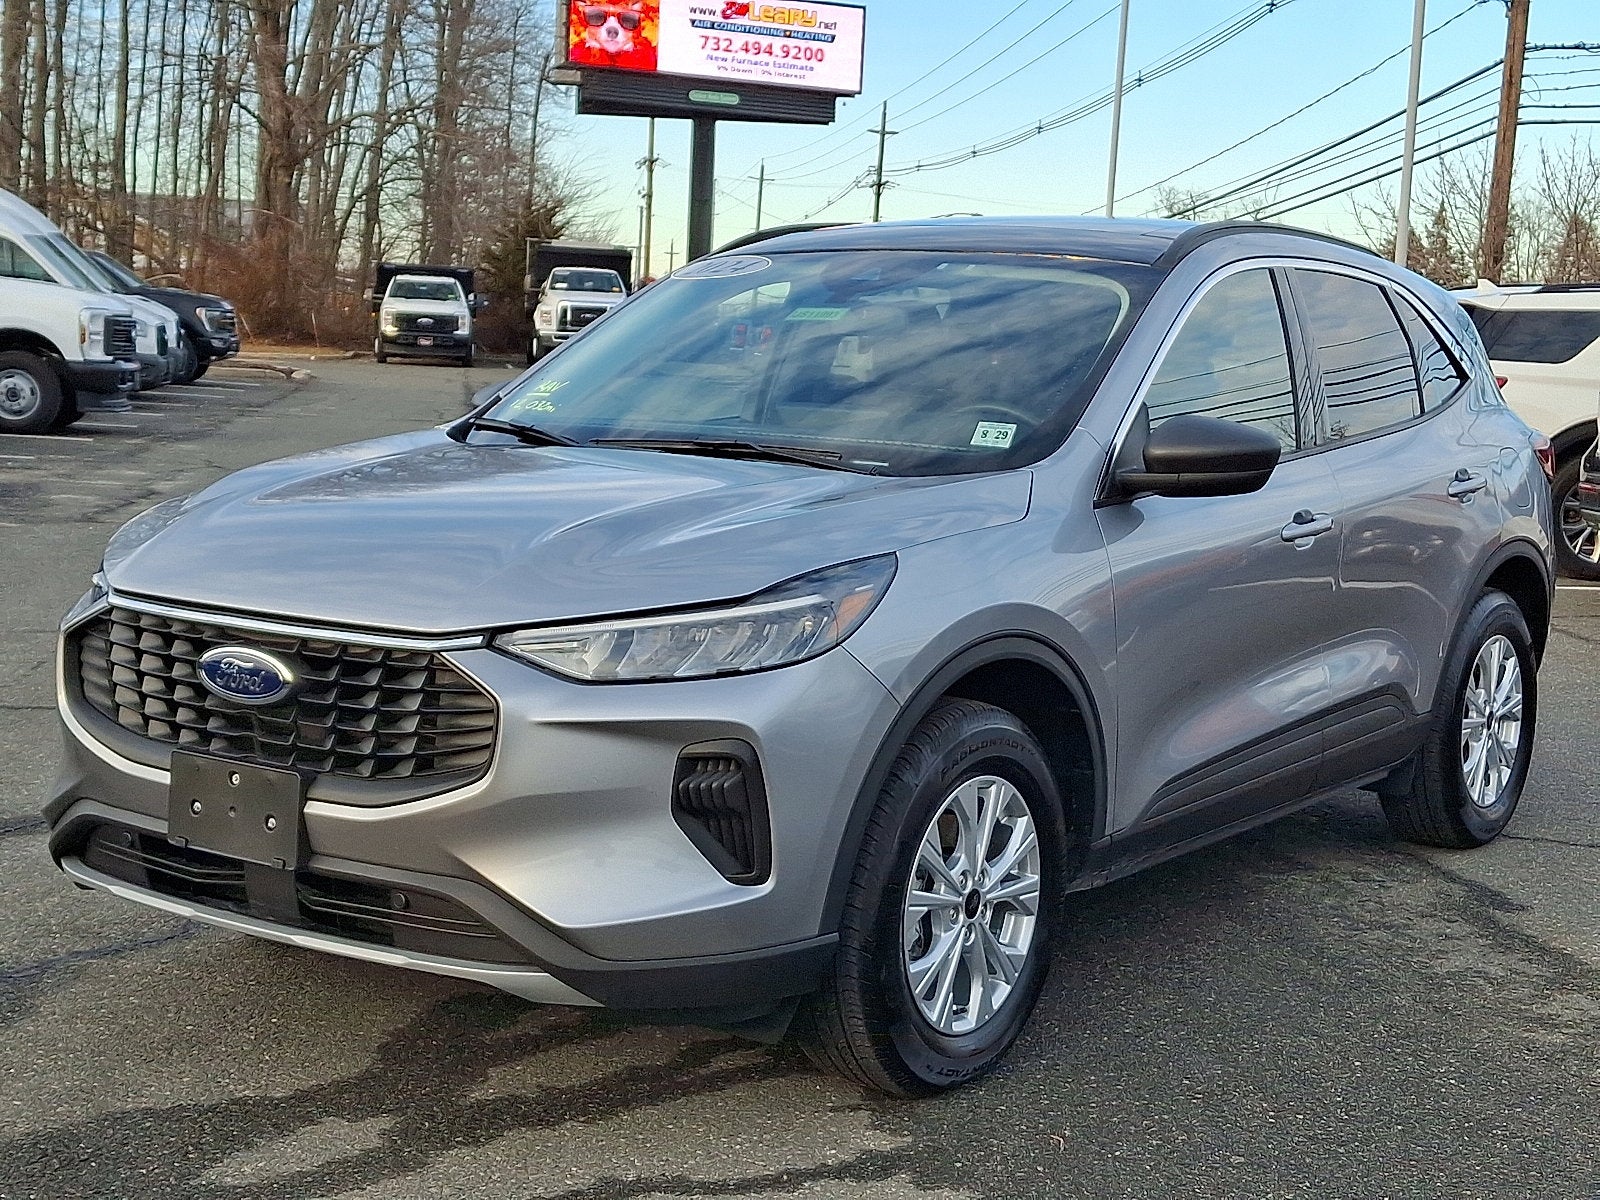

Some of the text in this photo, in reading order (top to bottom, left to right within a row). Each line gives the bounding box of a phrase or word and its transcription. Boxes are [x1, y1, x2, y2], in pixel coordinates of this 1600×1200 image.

[693, 19, 832, 42] AIR CONDITIONING HEATING
[701, 34, 826, 63] 732.494.9200
[706, 54, 815, 72] New Furnace Estimate
[980, 429, 1009, 440] 8 29
[215, 656, 266, 692] Ford
